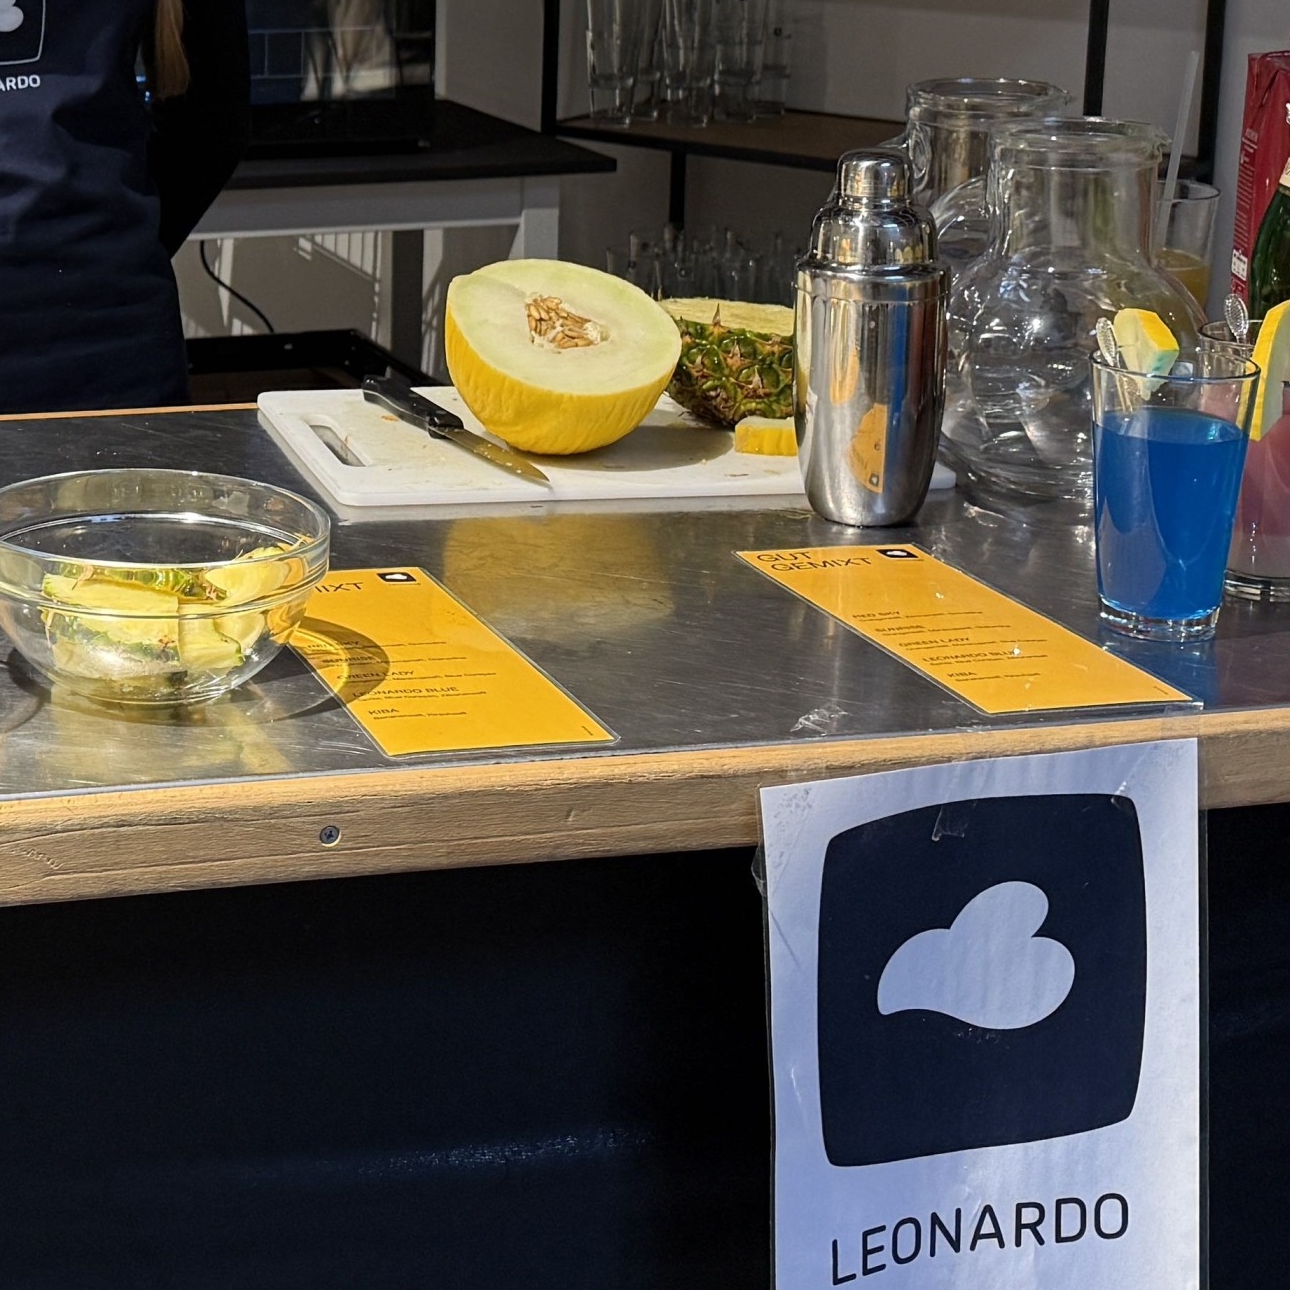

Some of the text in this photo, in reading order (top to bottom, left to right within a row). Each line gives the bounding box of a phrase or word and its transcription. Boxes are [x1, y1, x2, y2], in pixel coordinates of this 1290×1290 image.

[757, 551, 812, 562] GUT
[771, 557, 872, 571] GEMIXT
[899, 639, 939, 648] GREEN
[922, 652, 987, 663] LEONARDO
[988, 650, 1020, 658] BLU
[337, 672, 382, 680] GREEN
[353, 688, 423, 698] LEONARDO
[368, 708, 400, 716] KIBA
[831, 1192, 1129, 1286] LEONARDO
